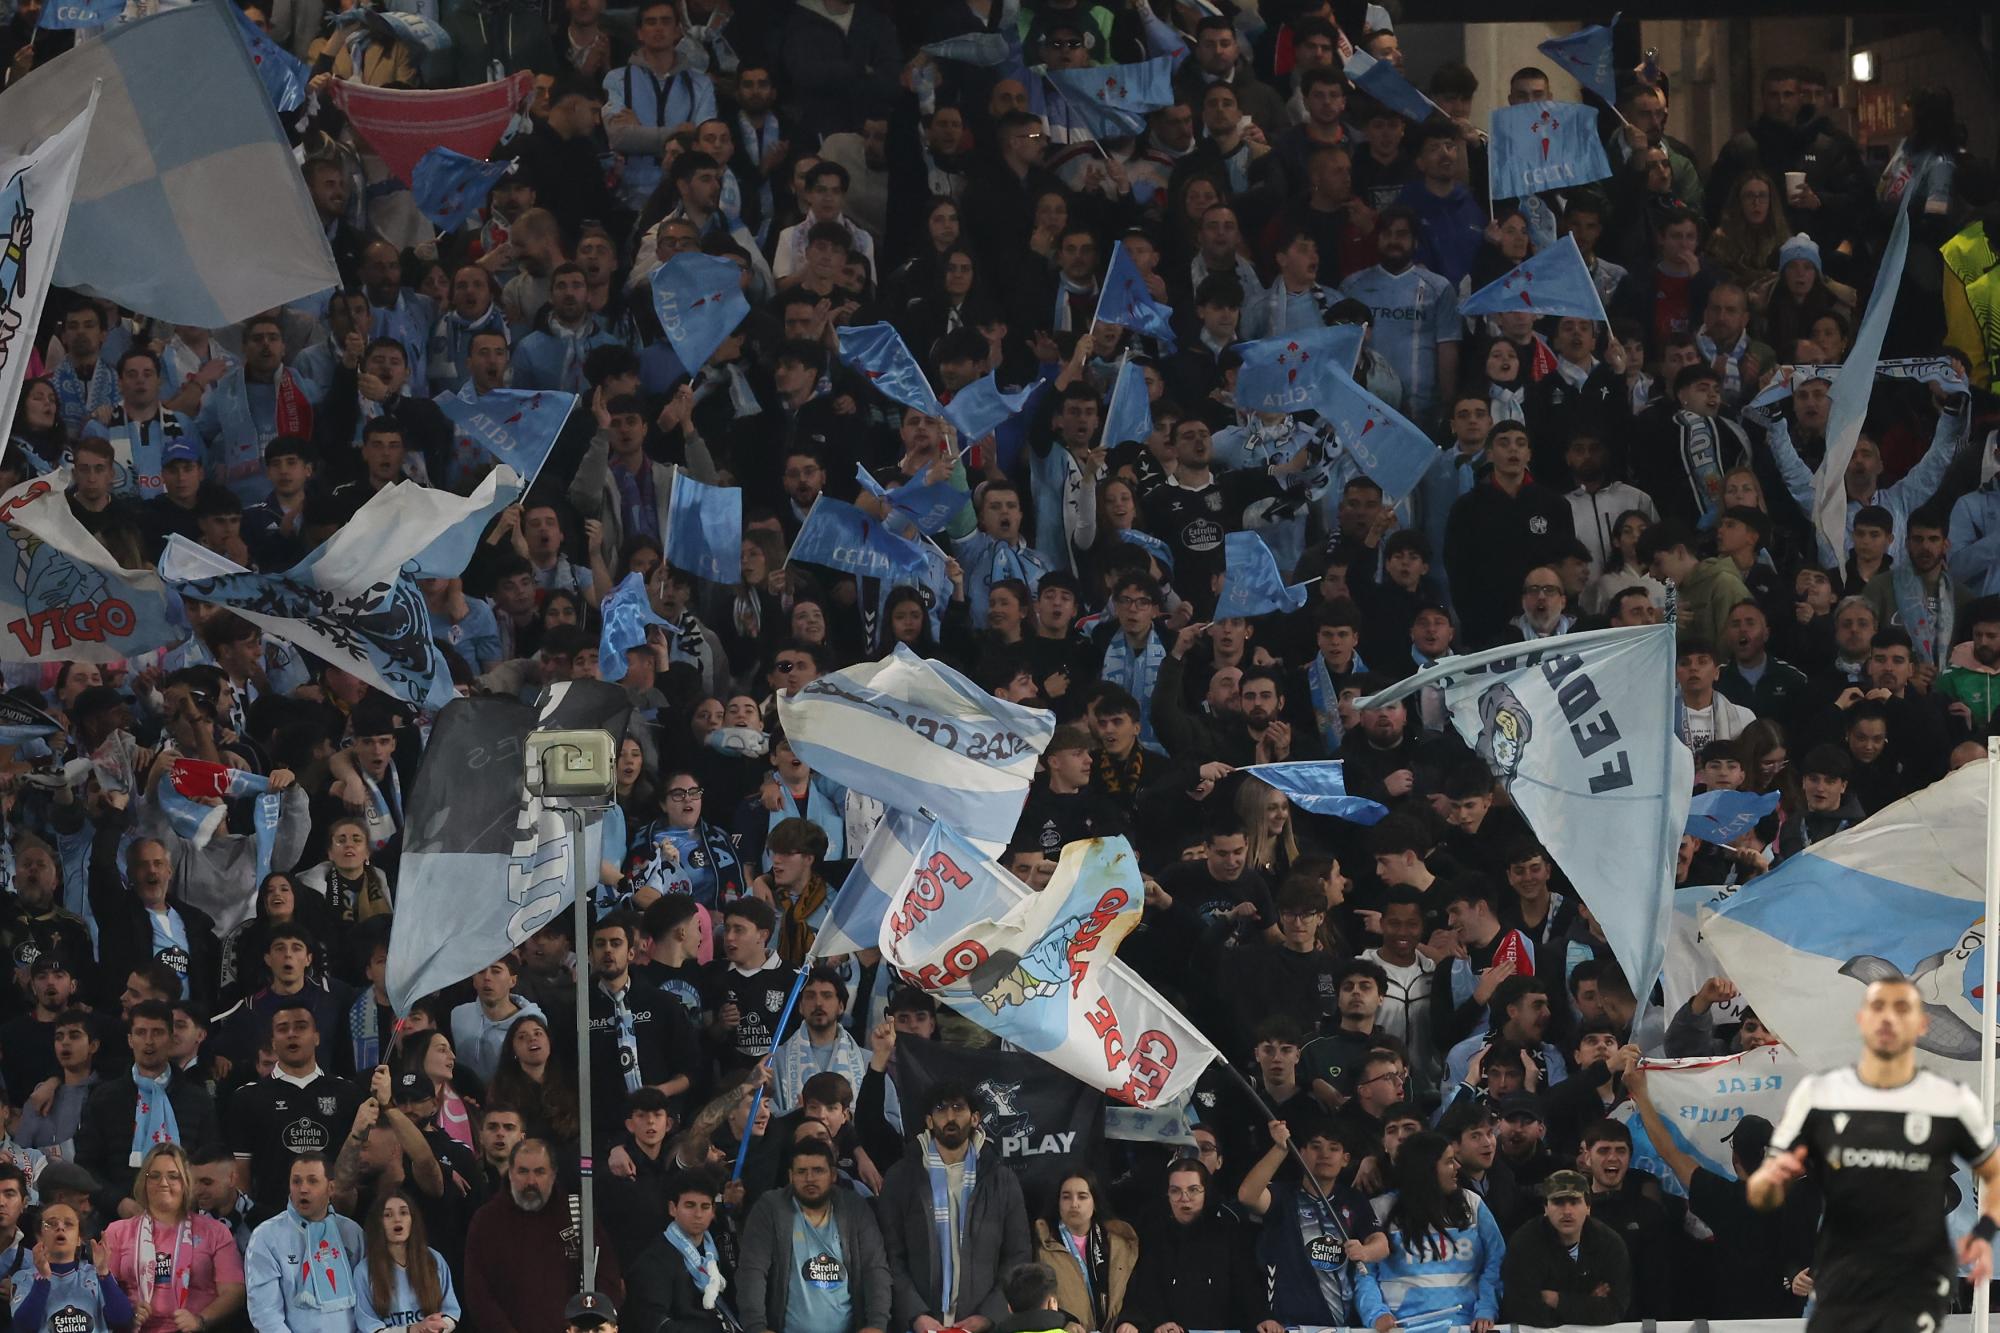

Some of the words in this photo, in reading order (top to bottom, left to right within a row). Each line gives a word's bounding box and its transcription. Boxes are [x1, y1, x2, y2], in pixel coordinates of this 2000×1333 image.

[1523, 163, 1575, 186] CELTA
[1369, 305, 1426, 321] TROËN
[1188, 526, 1217, 537] Estrella
[1189, 535, 1217, 545] Galicia
[832, 546, 889, 568] CELTA
[8, 597, 136, 656] VIGO
[263, 793, 281, 830] ELTA
[161, 952, 188, 965] Estrella
[290, 1127, 322, 1137] Estrella
[291, 1136, 320, 1145] Galicia
[1002, 1131, 1077, 1157] PLAY
[1311, 1240, 1342, 1254] Estrella
[1311, 1250, 1340, 1262] Galicia
[809, 1261, 840, 1272] Estrella
[810, 1270, 838, 1281] Galicia
[54, 1315, 87, 1326] Estrella
[56, 1324, 86, 1333] Galicia
